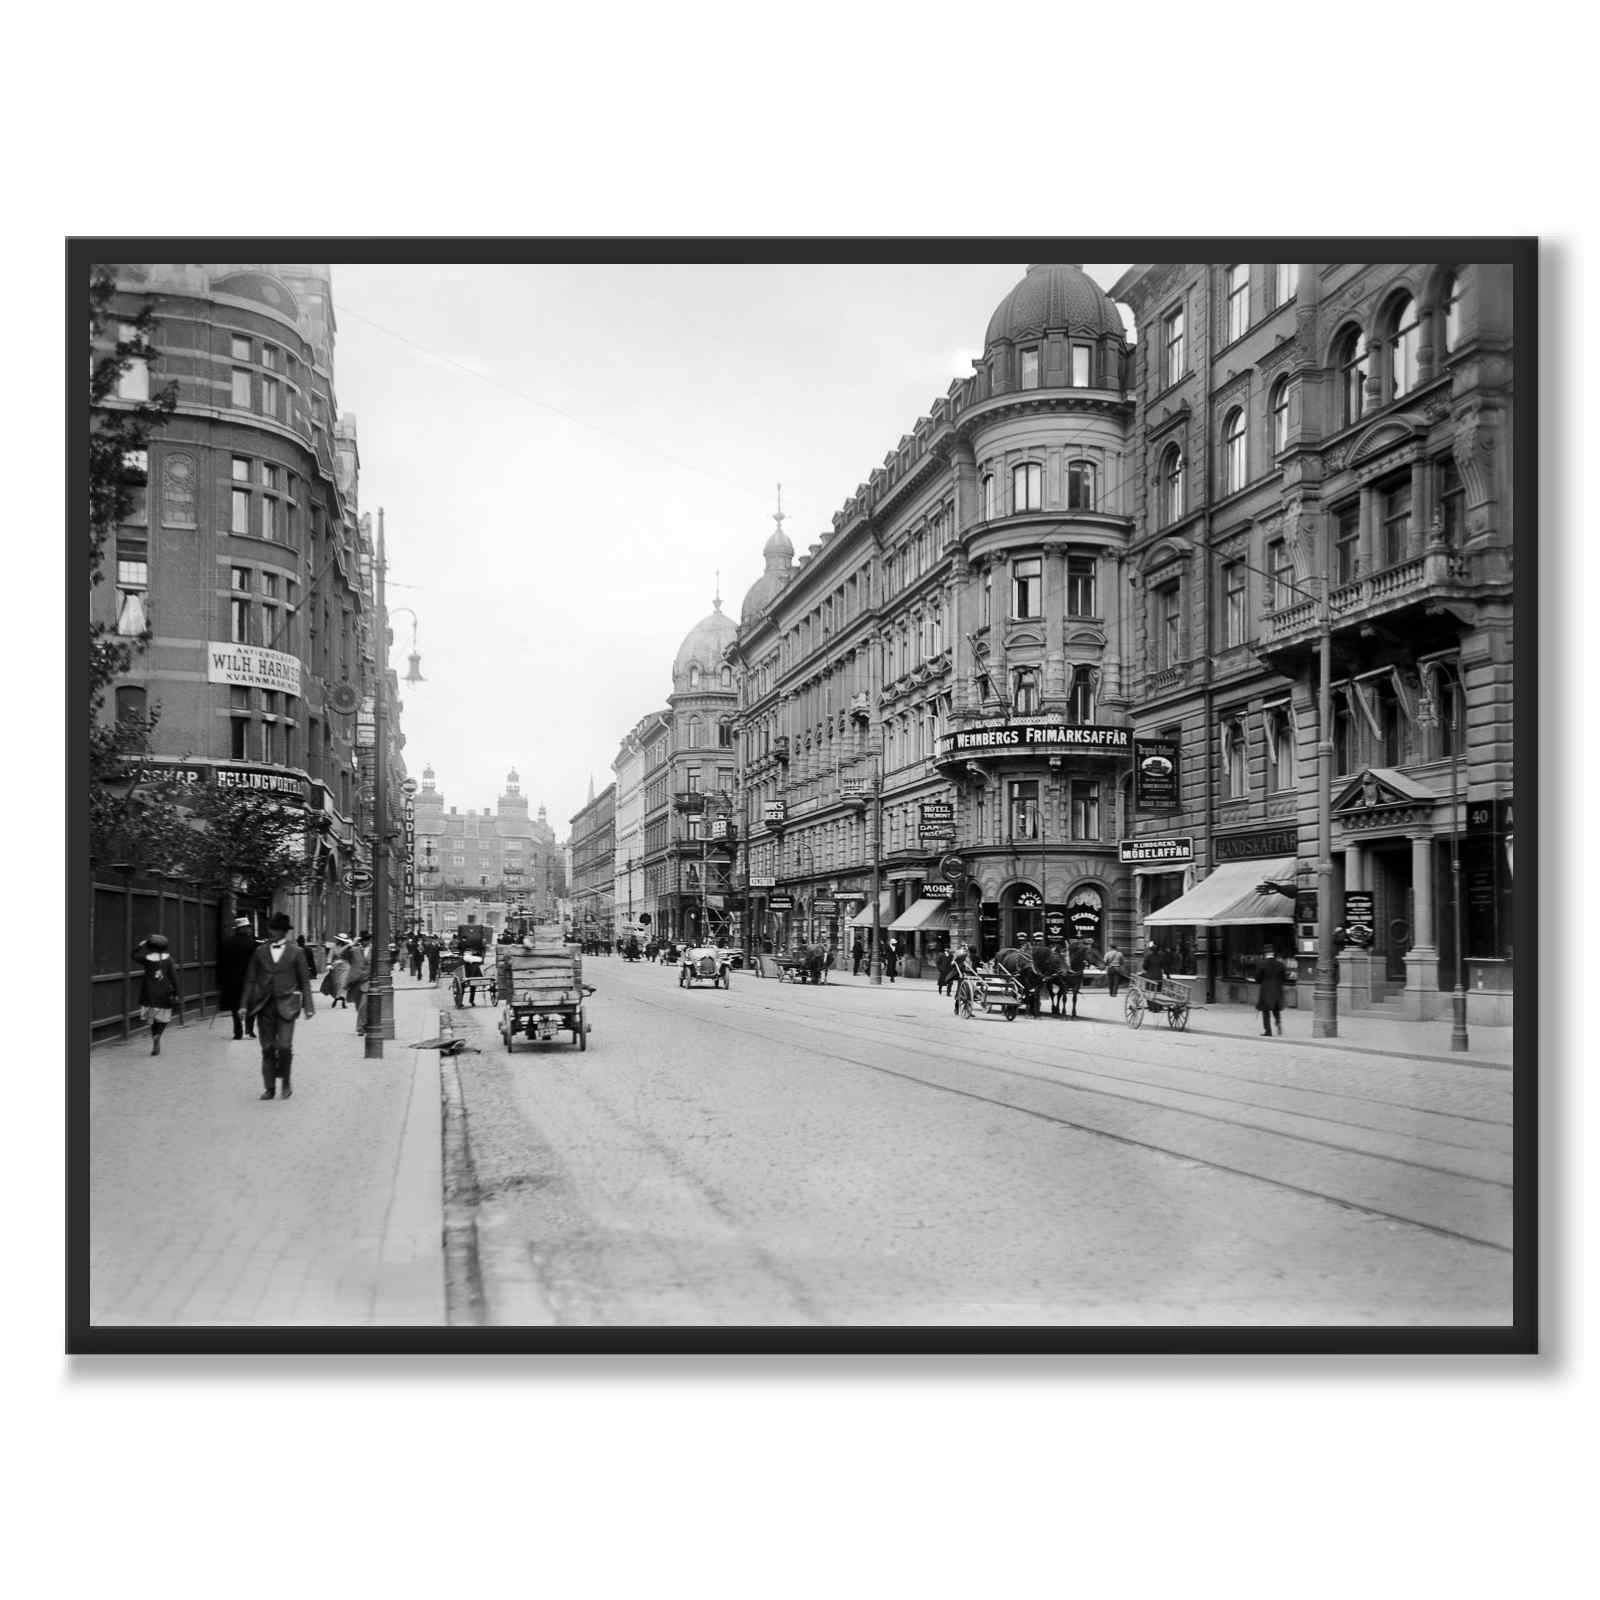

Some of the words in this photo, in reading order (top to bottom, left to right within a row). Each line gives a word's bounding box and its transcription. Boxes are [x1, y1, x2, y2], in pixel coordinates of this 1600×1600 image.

[957, 730, 1019, 748] WENNBERGS
[1026, 726, 1128, 745] FRIMÄRKSAFFÄR
[1472, 810, 1488, 824] 40
[1122, 845, 1190, 860] MÖBELAFFÄR
[923, 884, 954, 893] MODE
